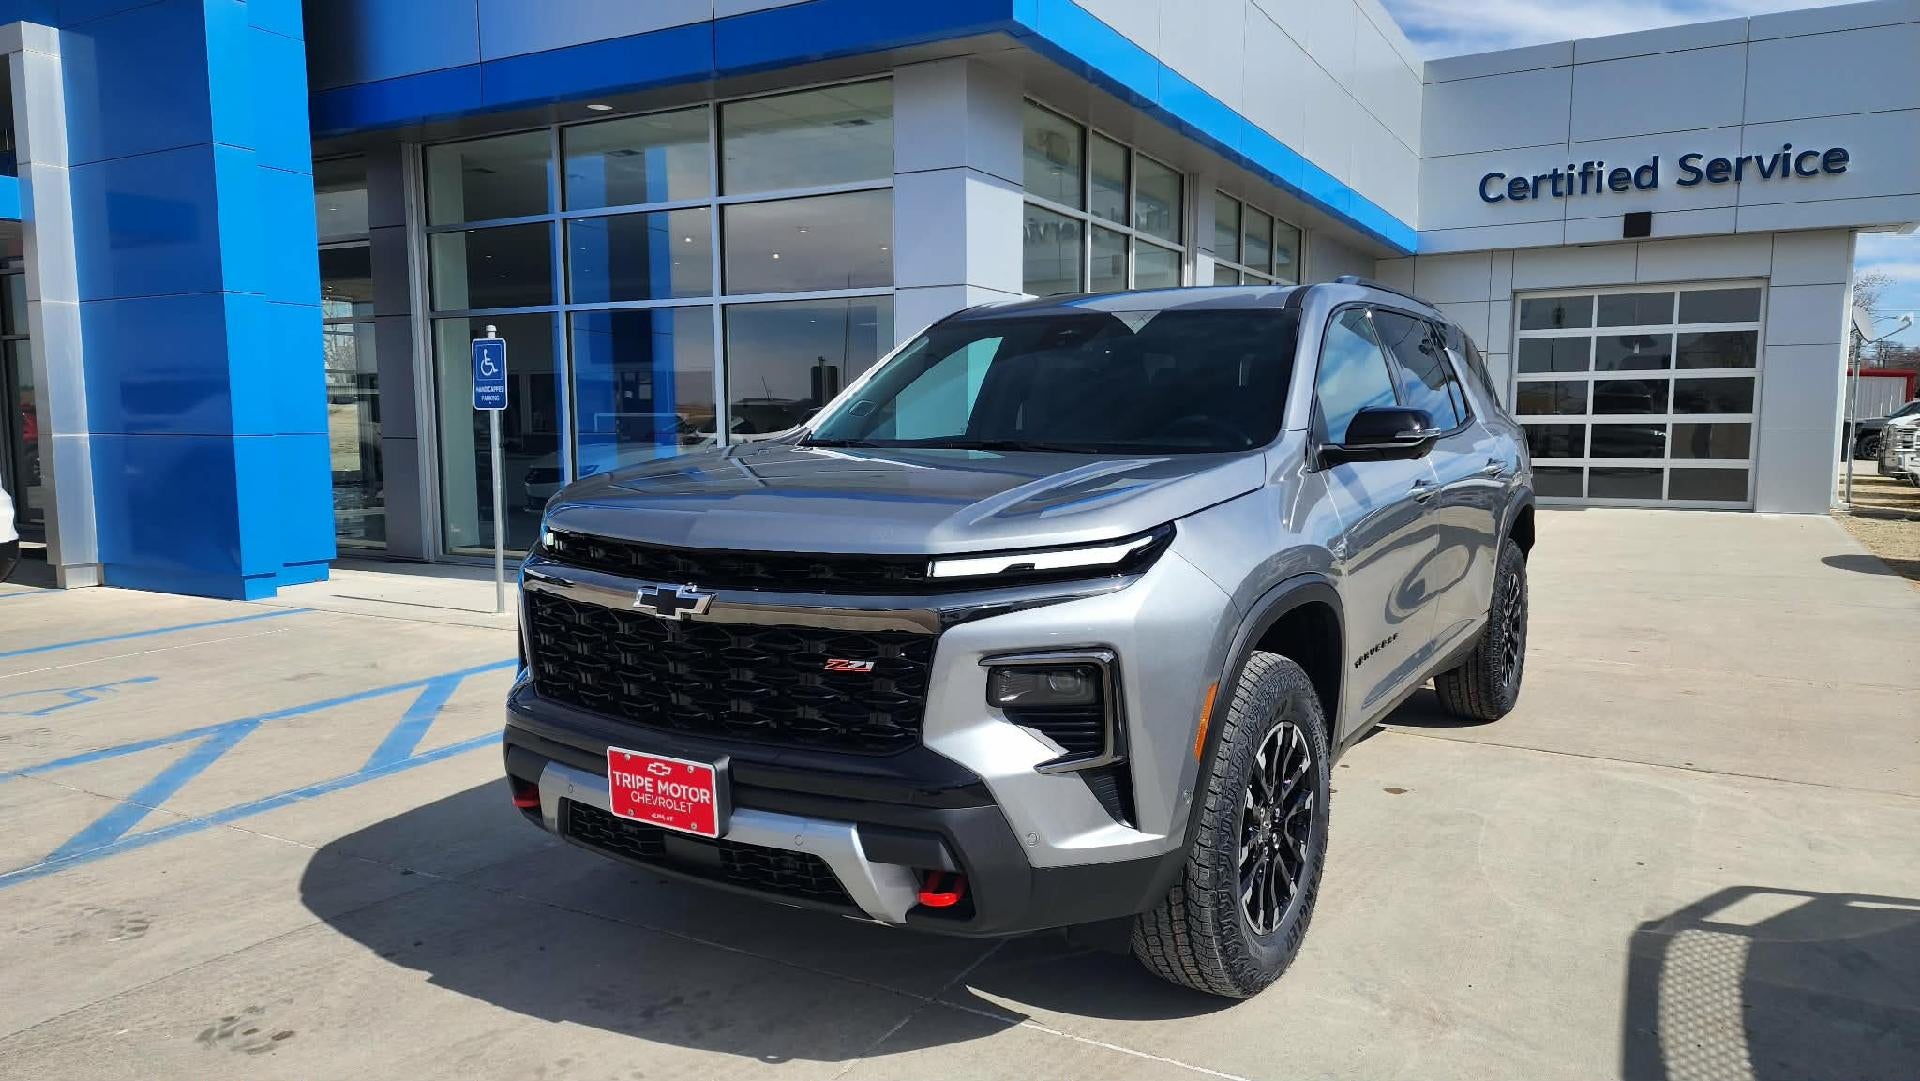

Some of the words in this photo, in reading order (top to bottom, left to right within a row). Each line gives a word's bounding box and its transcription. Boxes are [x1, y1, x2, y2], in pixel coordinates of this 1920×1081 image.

[1479, 156, 1659, 203] Certified
[1677, 143, 1850, 187] Service
[824, 658, 875, 672] Z71
[613, 771, 654, 793] TRIPE
[657, 780, 711, 804] MOTOR
[630, 790, 694, 814] CHEVROLET
